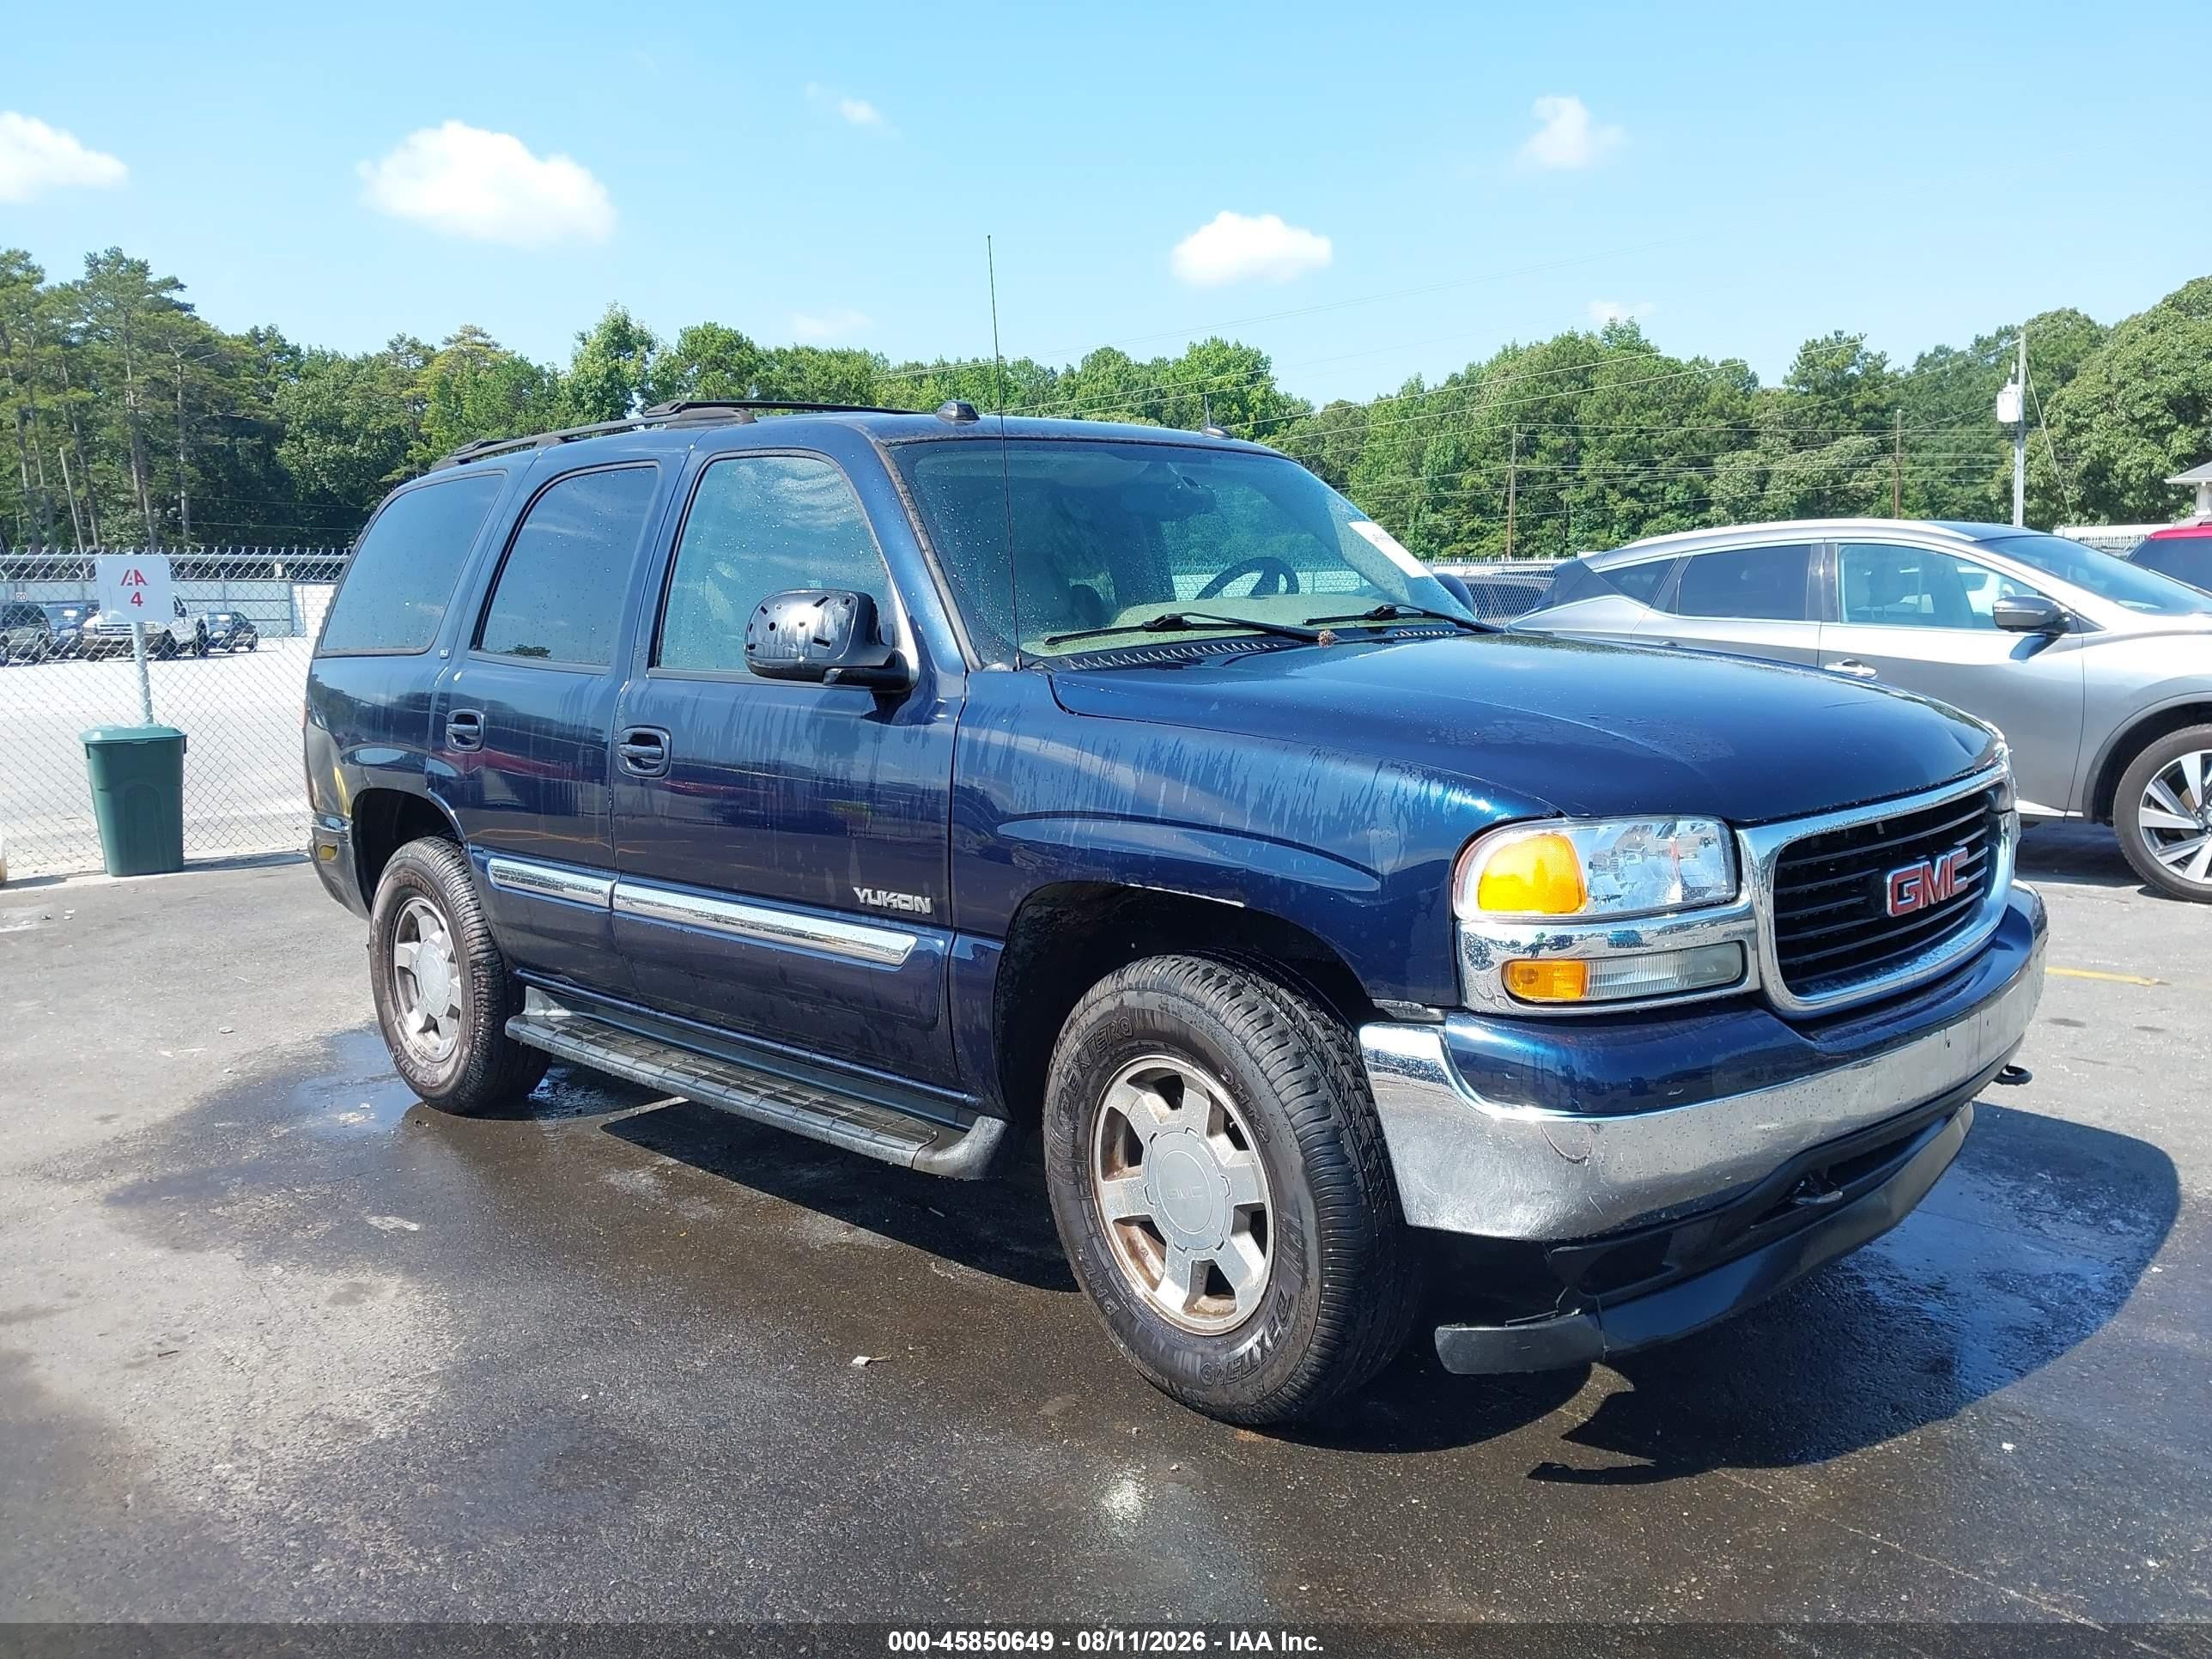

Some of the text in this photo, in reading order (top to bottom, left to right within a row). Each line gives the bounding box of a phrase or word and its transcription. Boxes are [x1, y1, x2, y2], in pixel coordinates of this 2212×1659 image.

[130, 591, 143, 607] 4
[1887, 847, 1969, 917] GMC
[852, 886, 933, 915] YUKON
